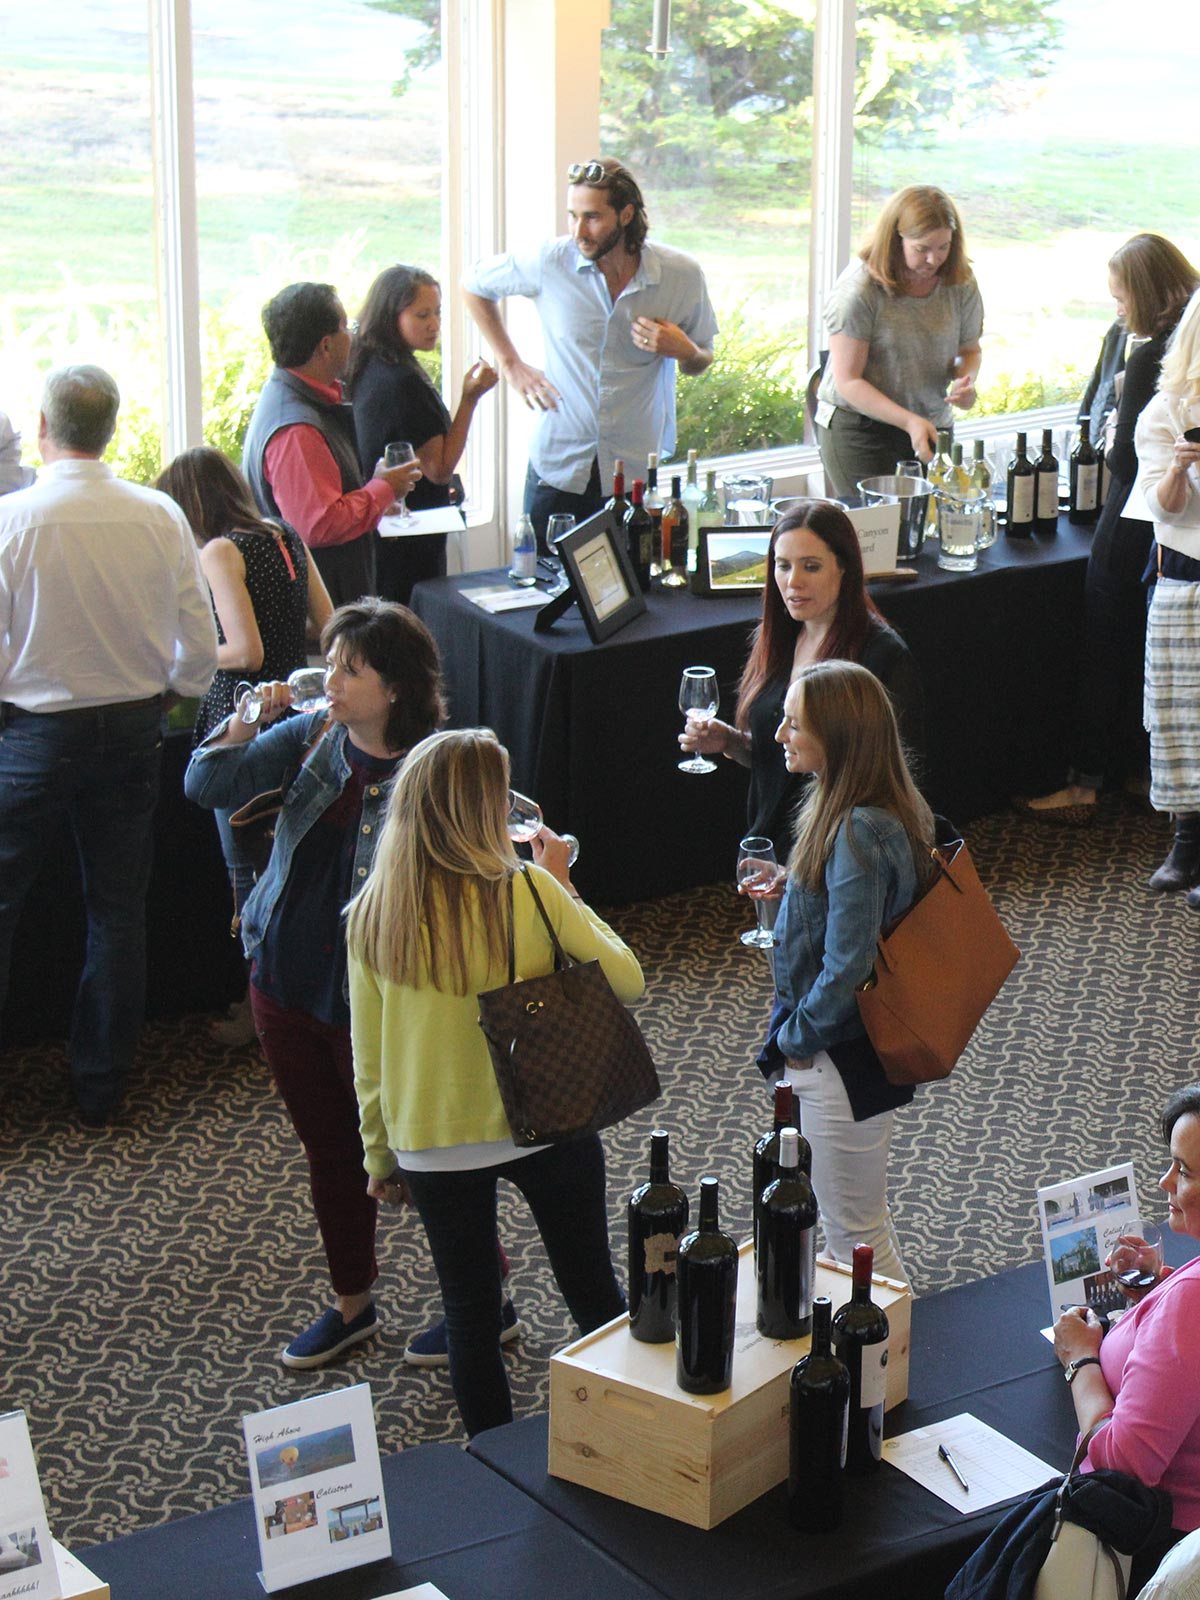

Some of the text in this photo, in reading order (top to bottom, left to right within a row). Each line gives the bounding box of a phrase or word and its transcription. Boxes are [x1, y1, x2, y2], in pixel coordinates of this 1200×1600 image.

[253, 1426, 301, 1443] High Above
[316, 1482, 353, 1499] Calistoga
